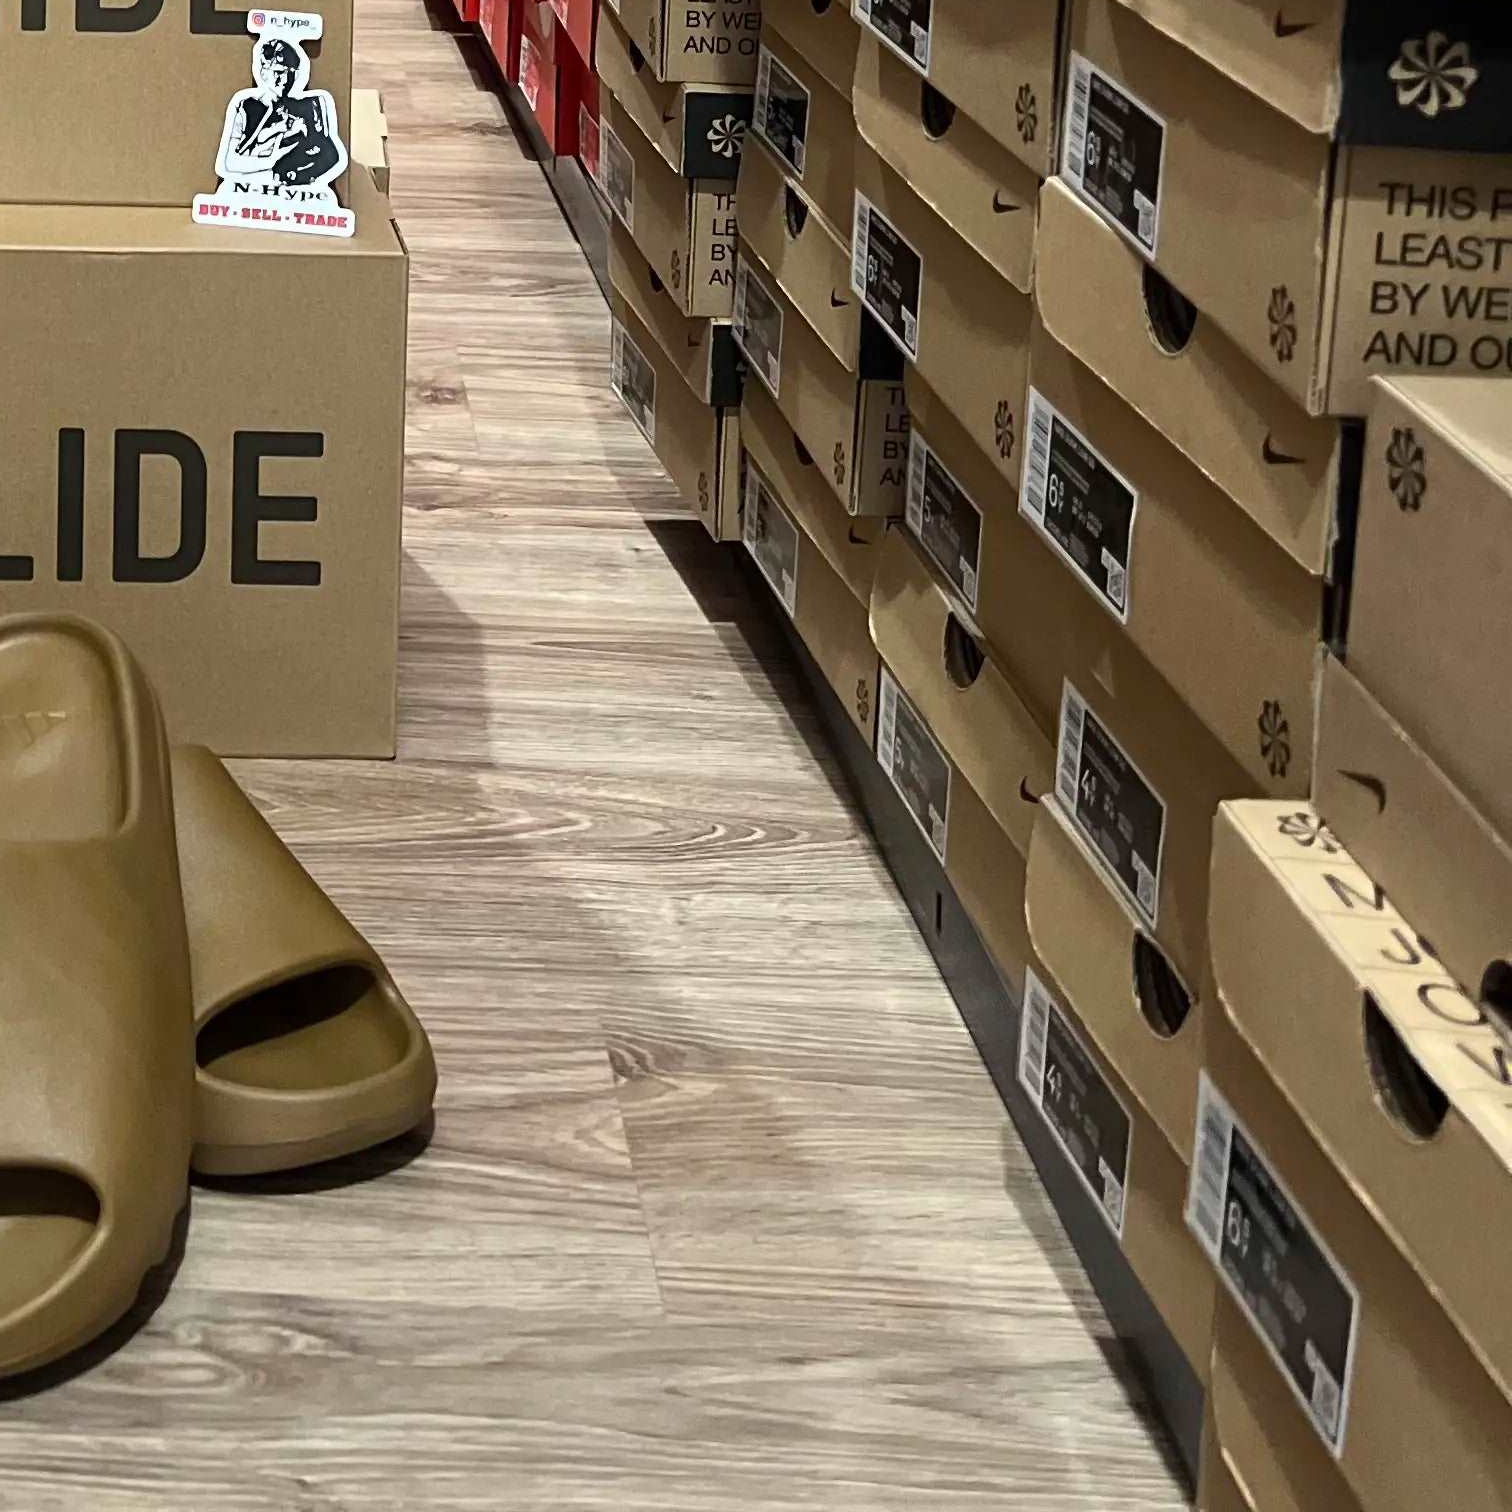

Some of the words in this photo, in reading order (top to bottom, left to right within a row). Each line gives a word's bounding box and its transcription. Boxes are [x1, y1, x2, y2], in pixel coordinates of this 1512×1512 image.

[685, 9, 717, 30] BY
[683, 35, 732, 55] AND
[234, 181, 329, 202] N-Hype
[1378, 181, 1477, 221] THIS
[199, 203, 230, 217] BUY
[241, 208, 282, 222] SELL
[294, 211, 348, 228] TRADE
[1375, 231, 1512, 273] LEAST
[1369, 280, 1431, 316] BY
[1361, 329, 1458, 367] AND
